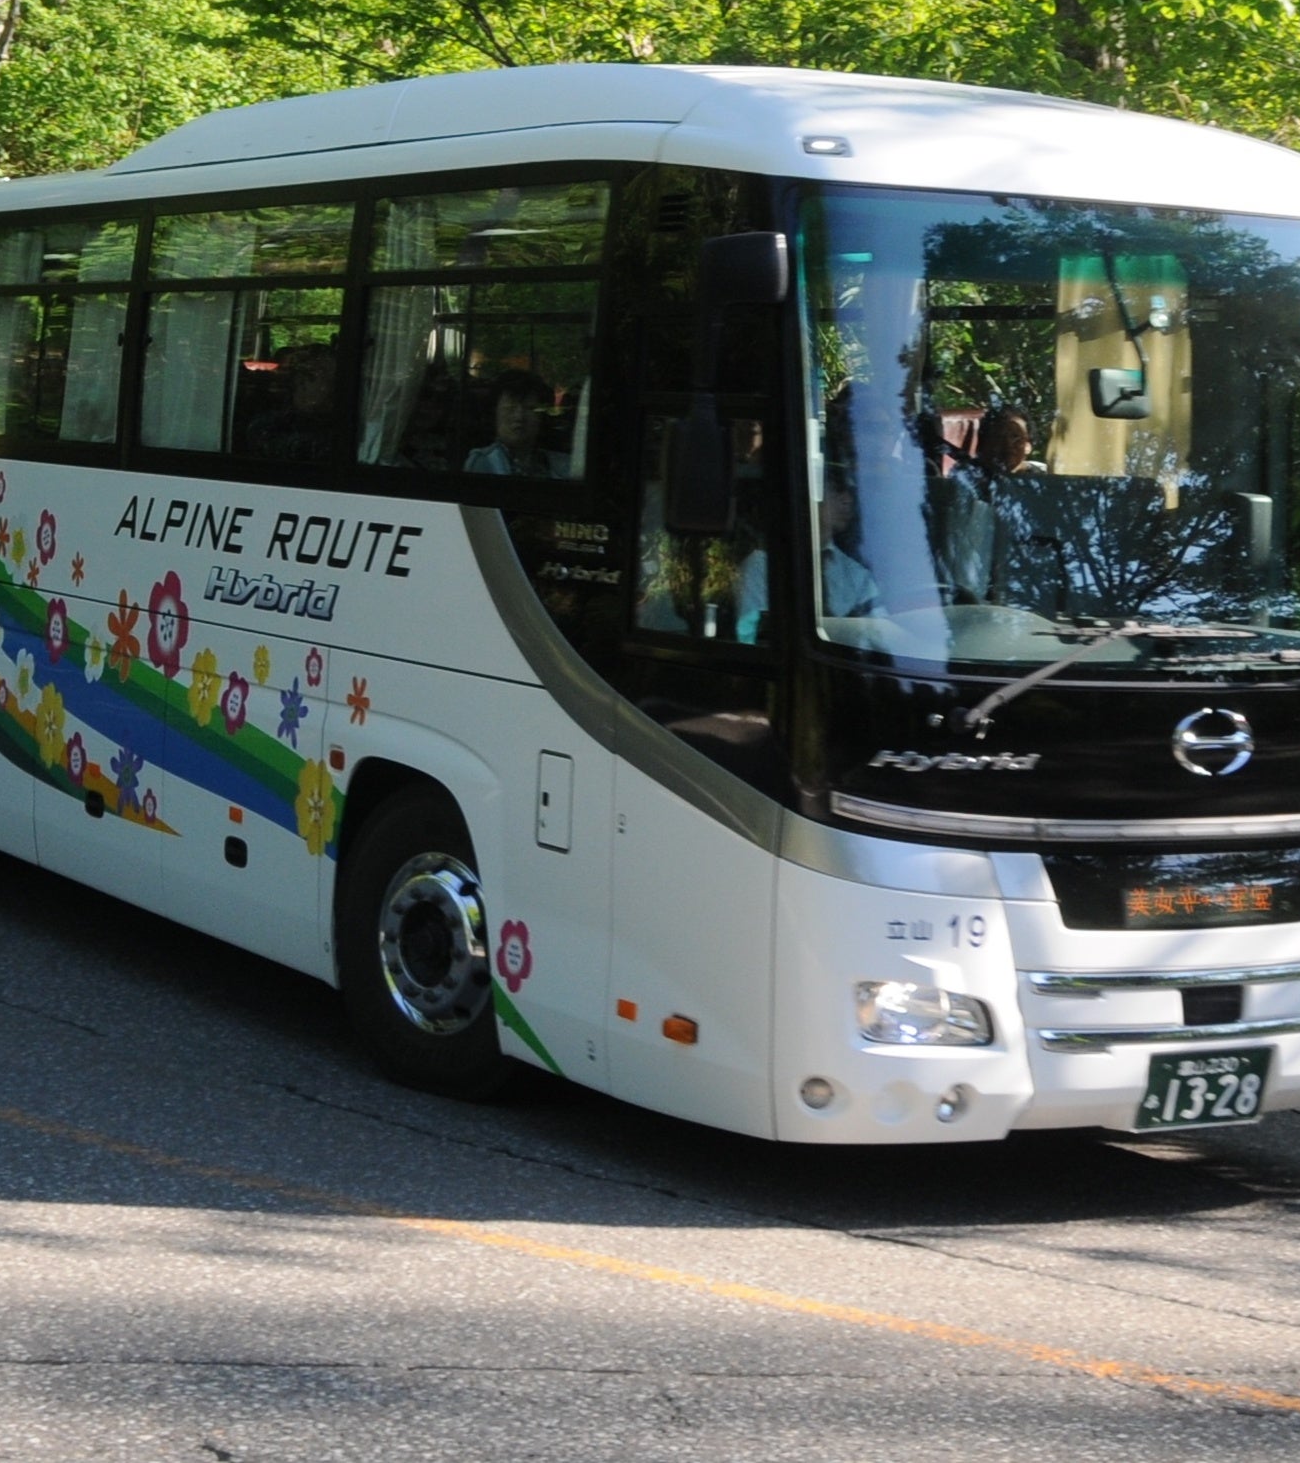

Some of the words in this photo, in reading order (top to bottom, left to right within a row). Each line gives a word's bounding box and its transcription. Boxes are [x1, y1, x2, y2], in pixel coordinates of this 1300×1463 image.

[114, 495, 254, 554] ALPINE
[266, 512, 424, 577] ROUTE
[203, 566, 341, 621] Hybrid
[868, 749, 1042, 772] Hybrid
[886, 918, 933, 940] 立山
[947, 914, 987, 948] 19
[1162, 1073, 1262, 1122] 13-28
